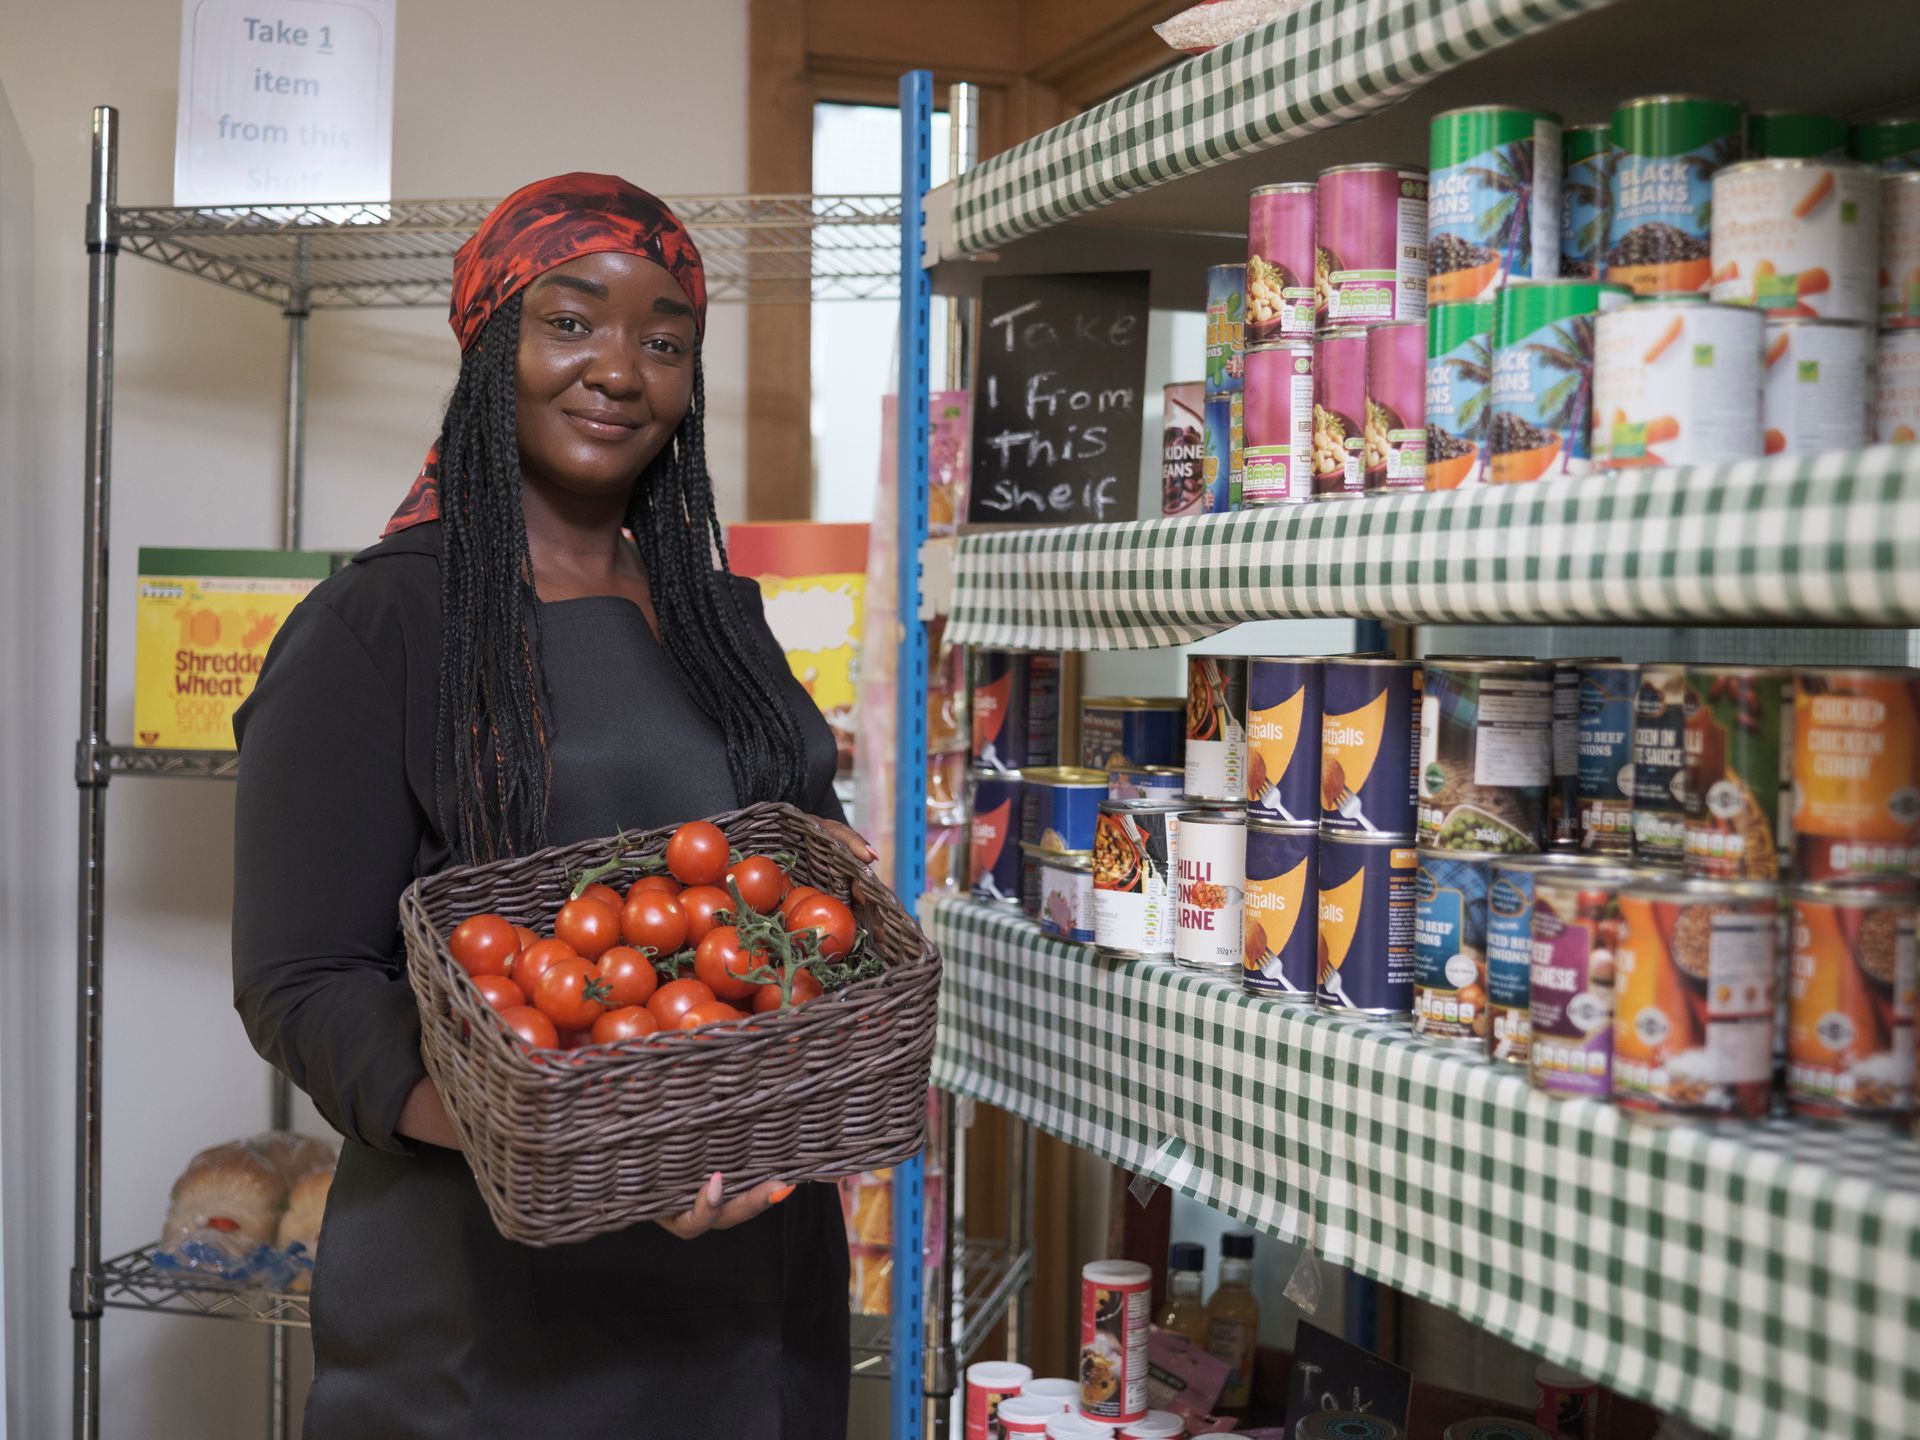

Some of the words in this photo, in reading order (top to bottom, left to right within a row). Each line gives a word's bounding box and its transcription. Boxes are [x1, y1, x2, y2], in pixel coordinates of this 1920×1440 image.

[244, 18, 308, 46] Take
[315, 26, 336, 55] 1
[254, 68, 320, 97] item
[218, 114, 288, 144] from
[298, 122, 351, 149] this
[1620, 164, 1689, 188] BLACK
[1619, 185, 1688, 208] BEANS
[989, 300, 1137, 352] Take
[175, 674, 243, 696] Wheat
[1594, 732, 1625, 744] BEEF
[1644, 748, 1682, 767] SAUCE
[1426, 922, 1453, 935] BEEF
